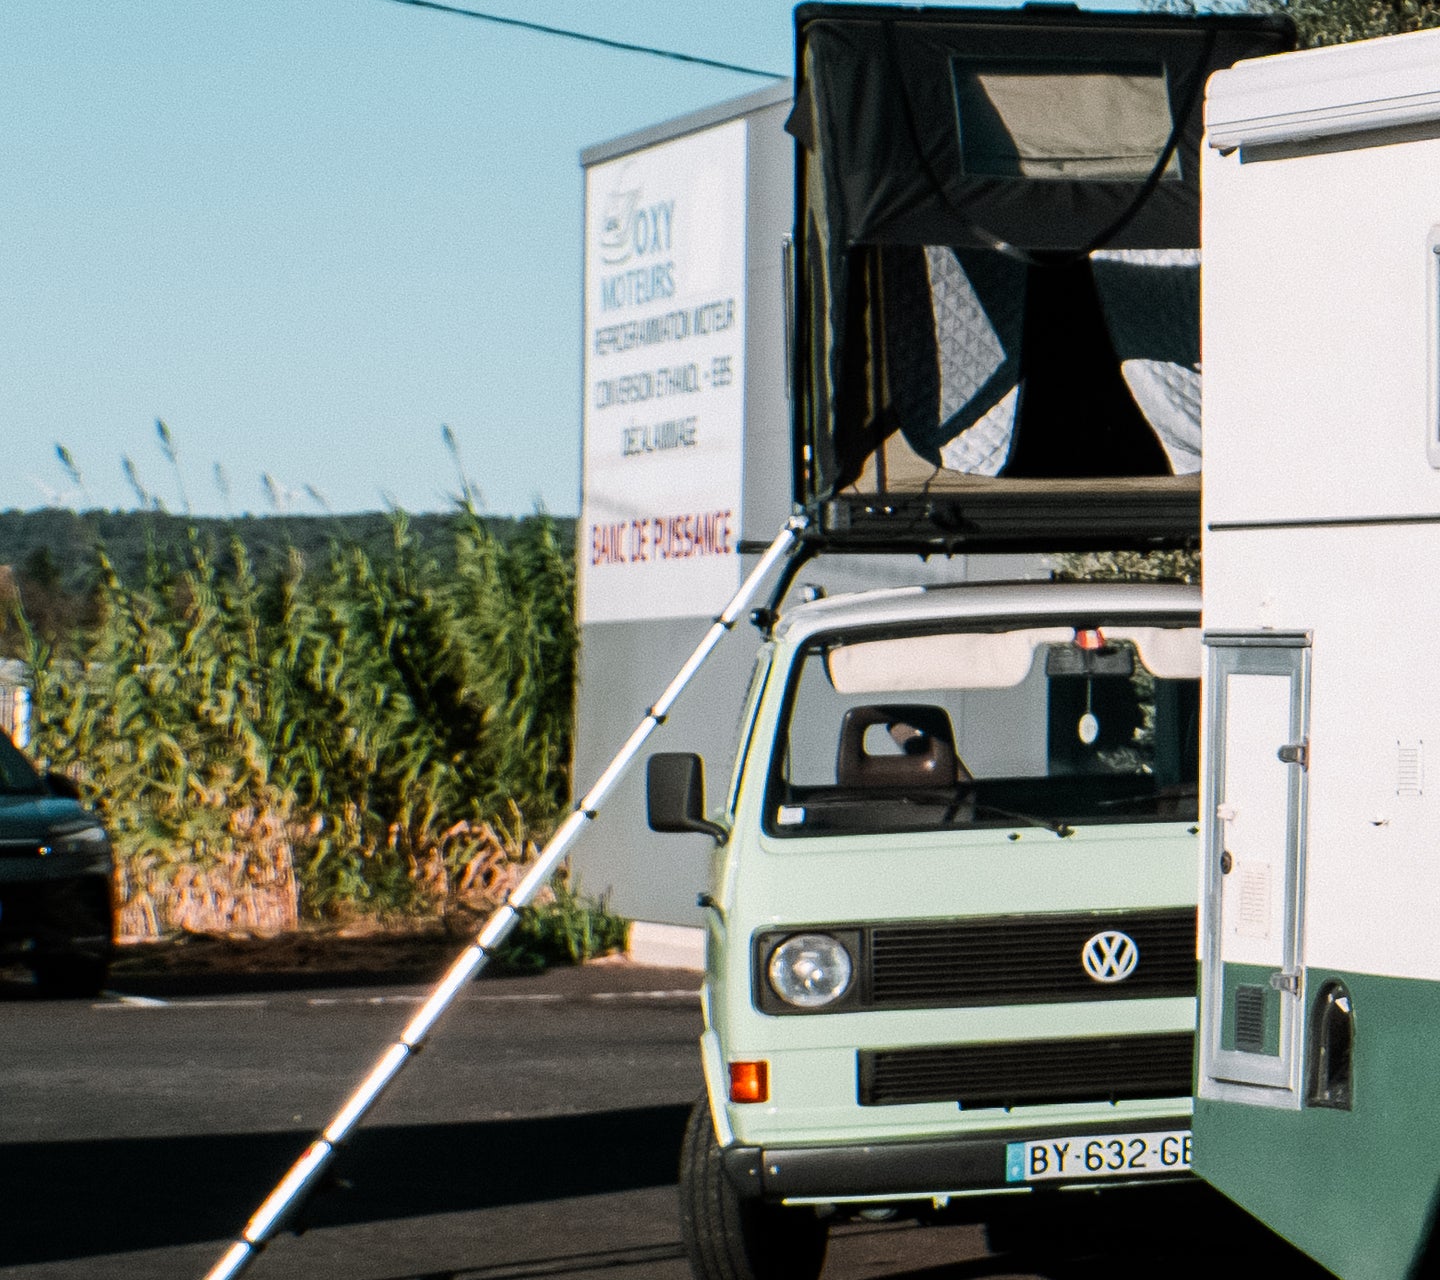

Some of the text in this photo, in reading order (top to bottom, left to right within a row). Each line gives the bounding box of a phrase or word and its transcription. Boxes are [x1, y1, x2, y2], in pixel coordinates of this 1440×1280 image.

[601, 260, 676, 311] MOTEURS
[592, 510, 732, 566] BANC DE PUISSANCE
